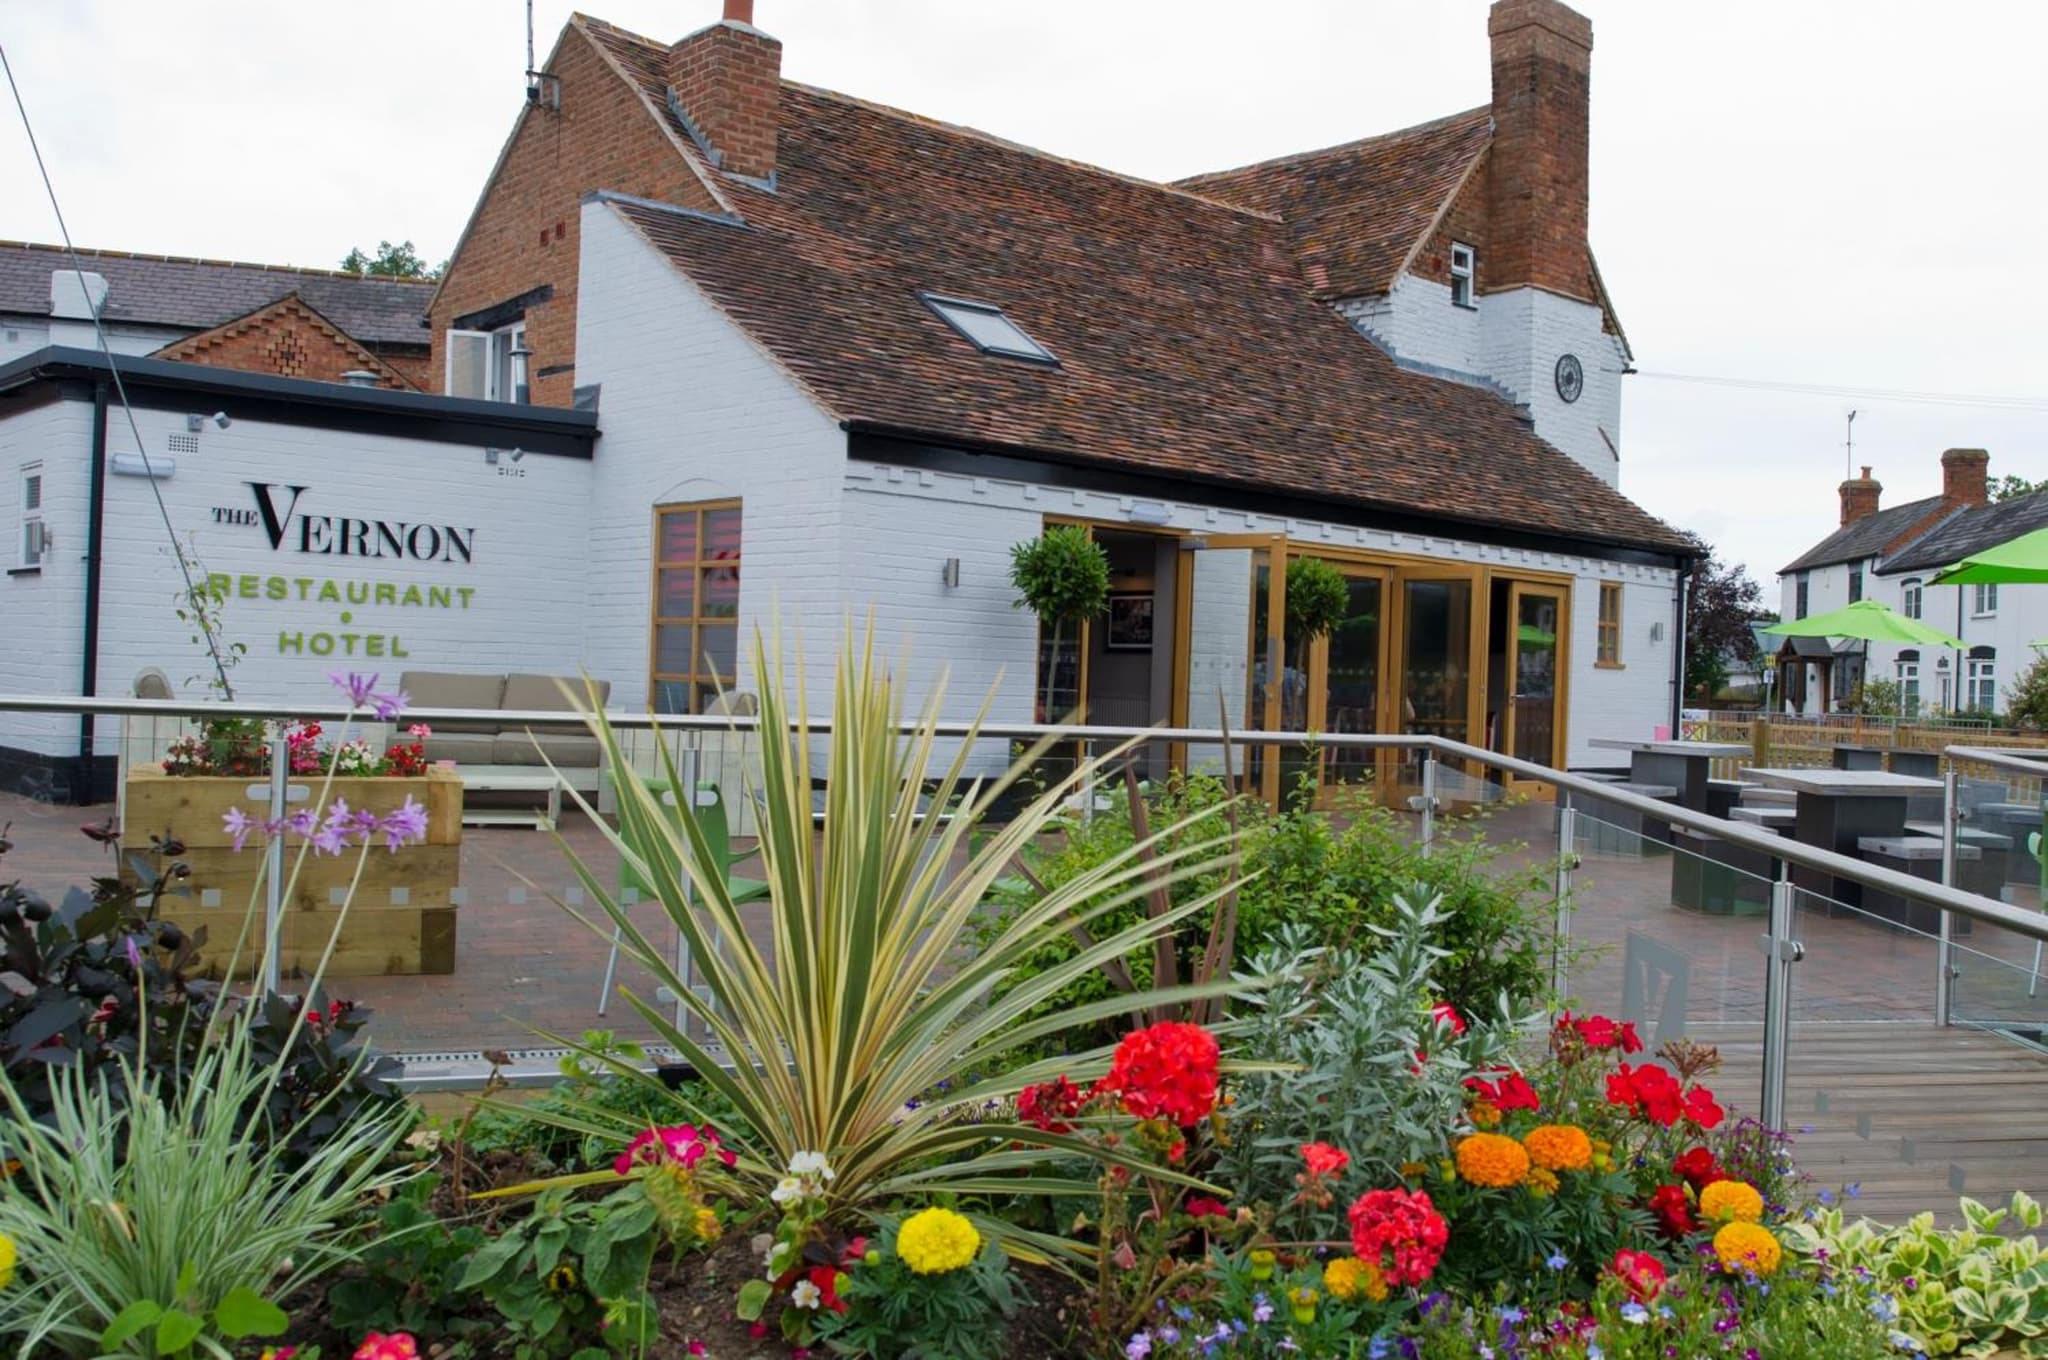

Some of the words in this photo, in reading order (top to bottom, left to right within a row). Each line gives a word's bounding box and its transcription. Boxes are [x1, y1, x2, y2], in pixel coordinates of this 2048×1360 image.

[211, 506, 259, 528] THE
[241, 482, 477, 563] VERNON
[207, 572, 476, 609] RESTAURANT
[278, 630, 410, 659] HOTEL
